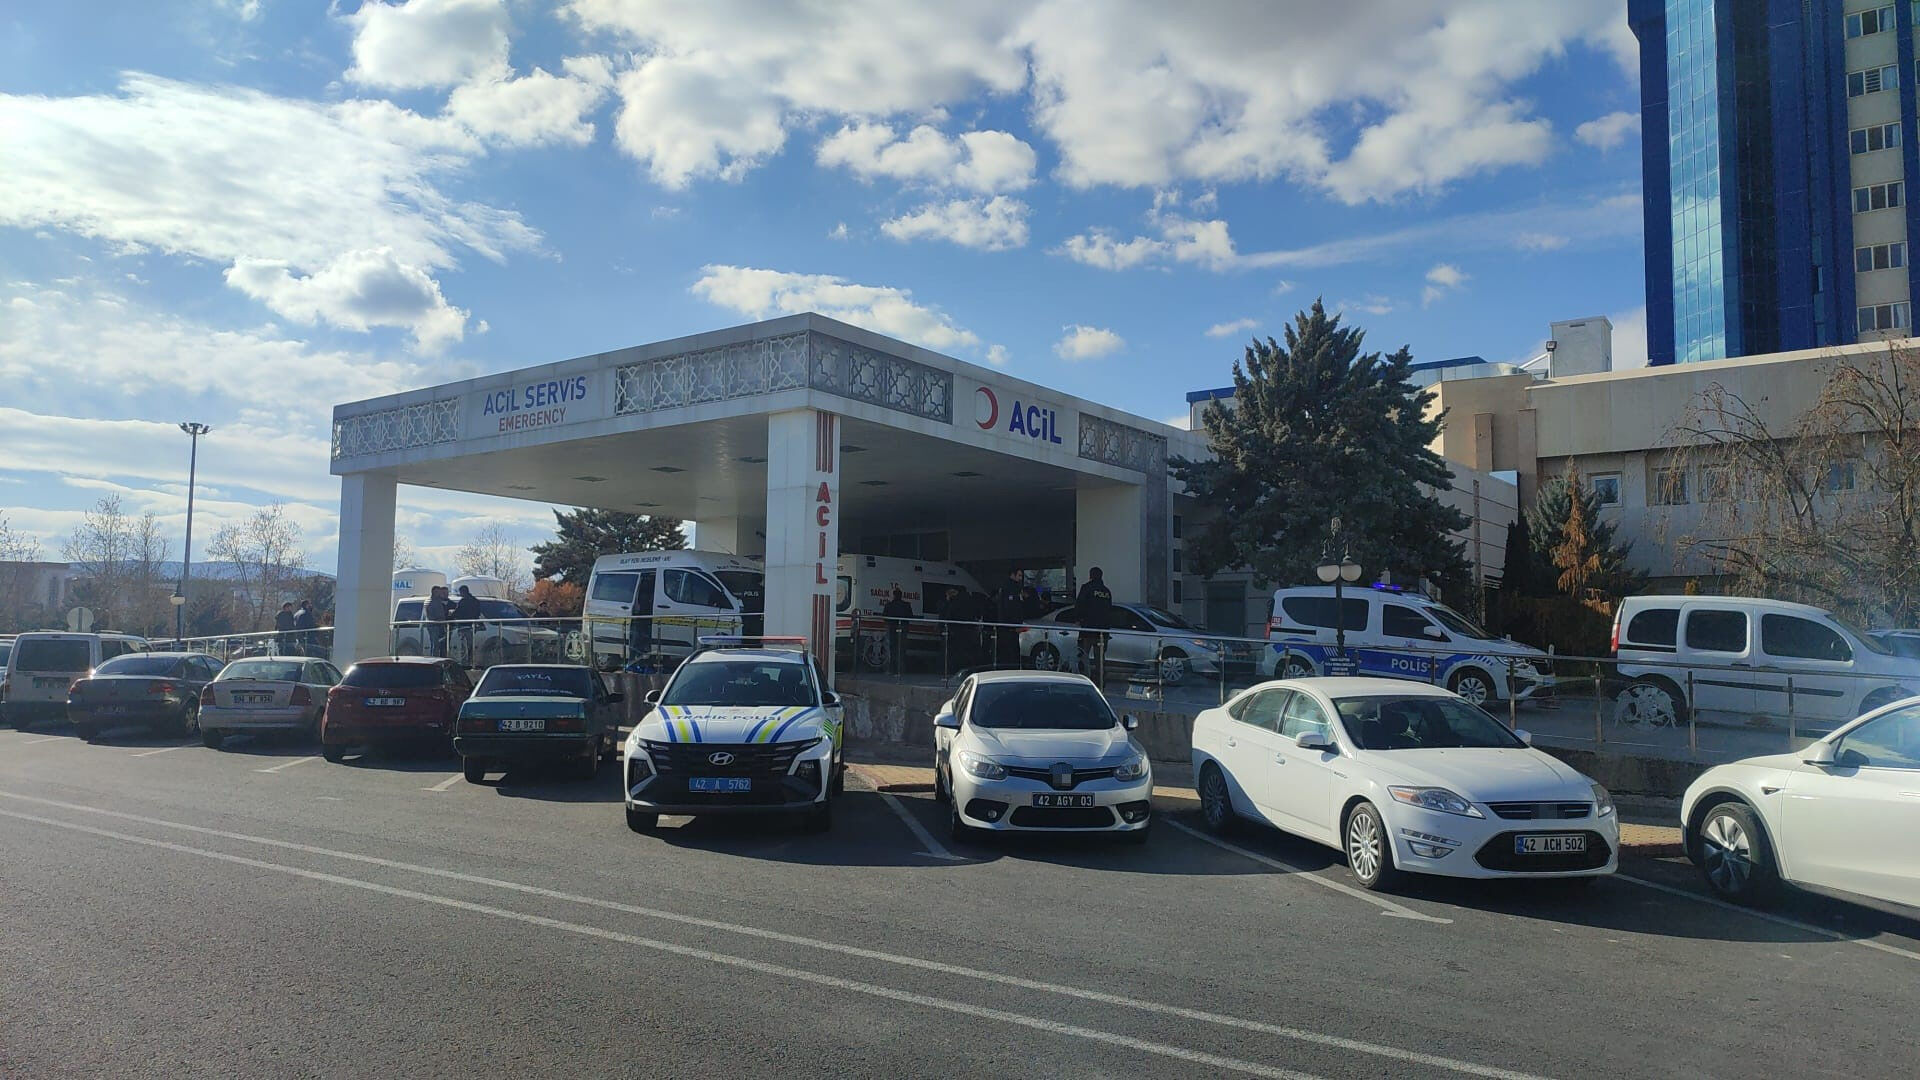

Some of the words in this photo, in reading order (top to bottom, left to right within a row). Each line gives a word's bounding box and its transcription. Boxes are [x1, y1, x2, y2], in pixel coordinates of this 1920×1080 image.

[499, 407, 567, 432] EMERGENCY
[502, 719, 513, 729] 42
[523, 719, 544, 729] 9210
[695, 779, 706, 790] 42
[714, 779, 721, 790] A
[728, 779, 749, 790] 5762
[1038, 795, 1050, 806] 42
[1056, 795, 1074, 806] AGY
[1080, 795, 1092, 806] 03
[1524, 838, 1537, 851] 42
[1543, 838, 1562, 851] ACH
[1565, 838, 1583, 850] 502
